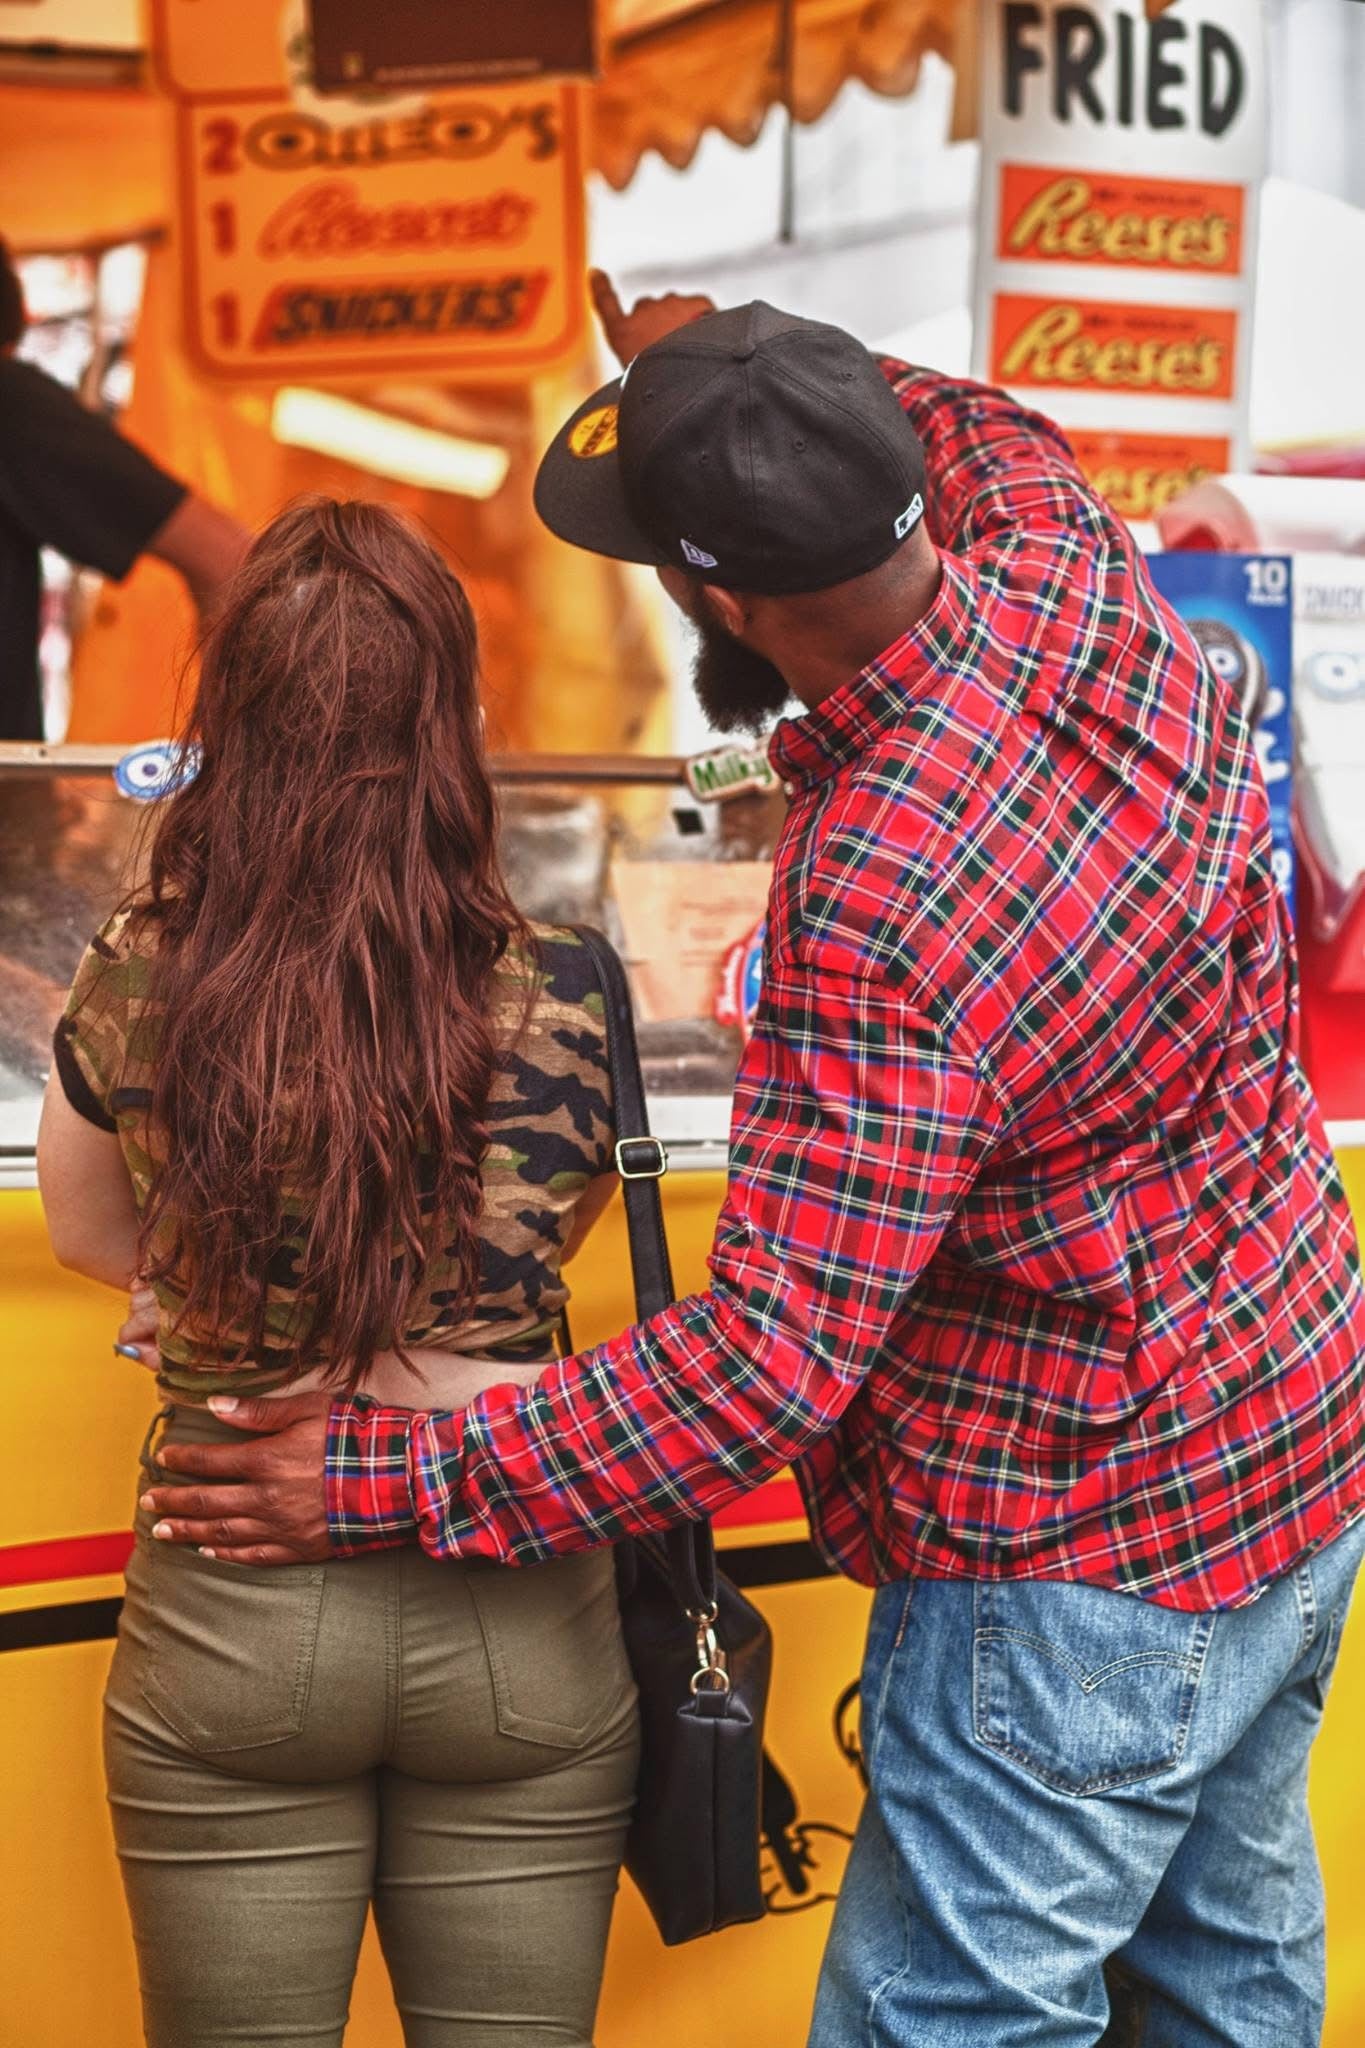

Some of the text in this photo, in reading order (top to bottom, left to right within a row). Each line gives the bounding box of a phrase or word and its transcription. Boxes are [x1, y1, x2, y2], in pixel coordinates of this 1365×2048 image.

[1001, 2, 1246, 139] FRIED
[203, 118, 239, 175] 2
[1243, 560, 1288, 596] 10
